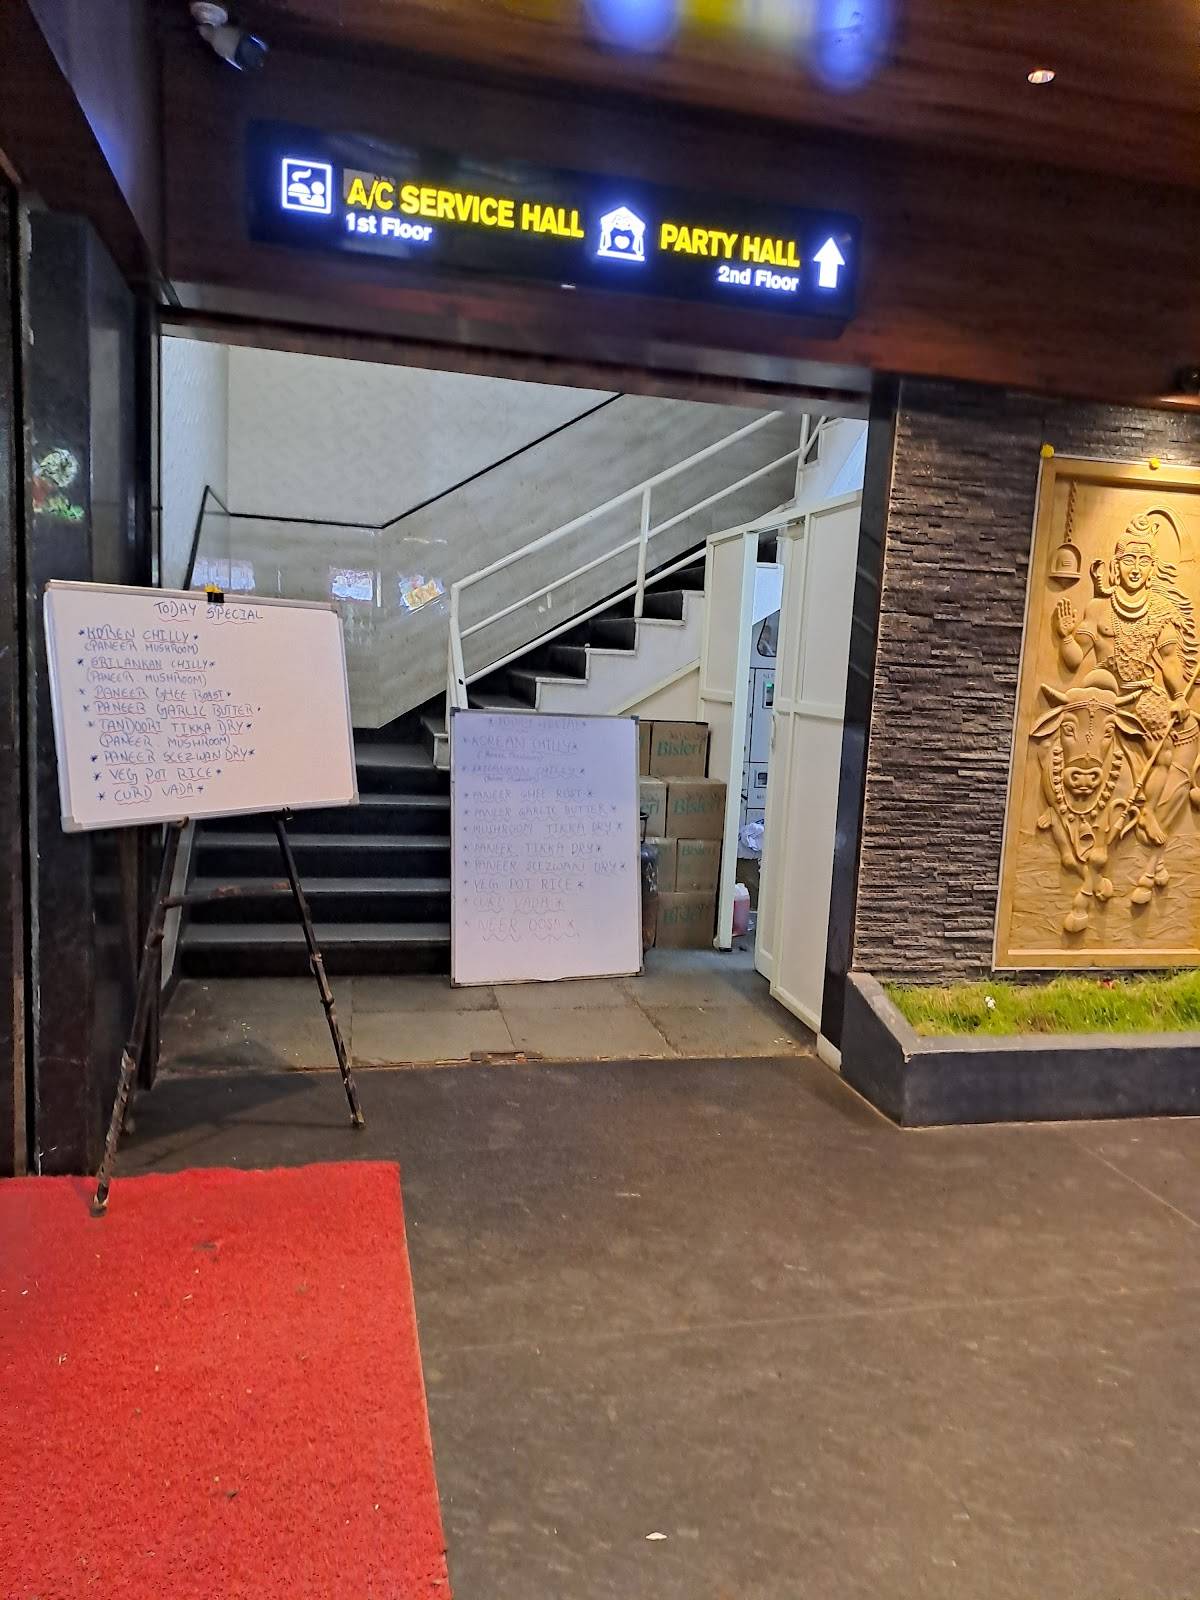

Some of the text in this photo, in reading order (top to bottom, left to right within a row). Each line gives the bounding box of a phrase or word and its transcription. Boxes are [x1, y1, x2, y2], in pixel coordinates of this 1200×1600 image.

[346, 178, 585, 239] A/C SERVICE HALL
[346, 212, 434, 242] 1st Floor
[660, 223, 800, 268] PARTY HALL
[717, 264, 800, 292] 2nd Floor
[154, 600, 264, 621] TODAY SPECIAL
[143, 629, 189, 643] CHILLY
[95, 702, 253, 719] PANEER GARLIC BUTTER
[171, 722, 212, 736] TIKKA
[218, 719, 244, 735] DRY
[225, 745, 248, 760] DRY
[109, 767, 213, 784] VEG POT RICE
[114, 783, 194, 801] CURD VADA
